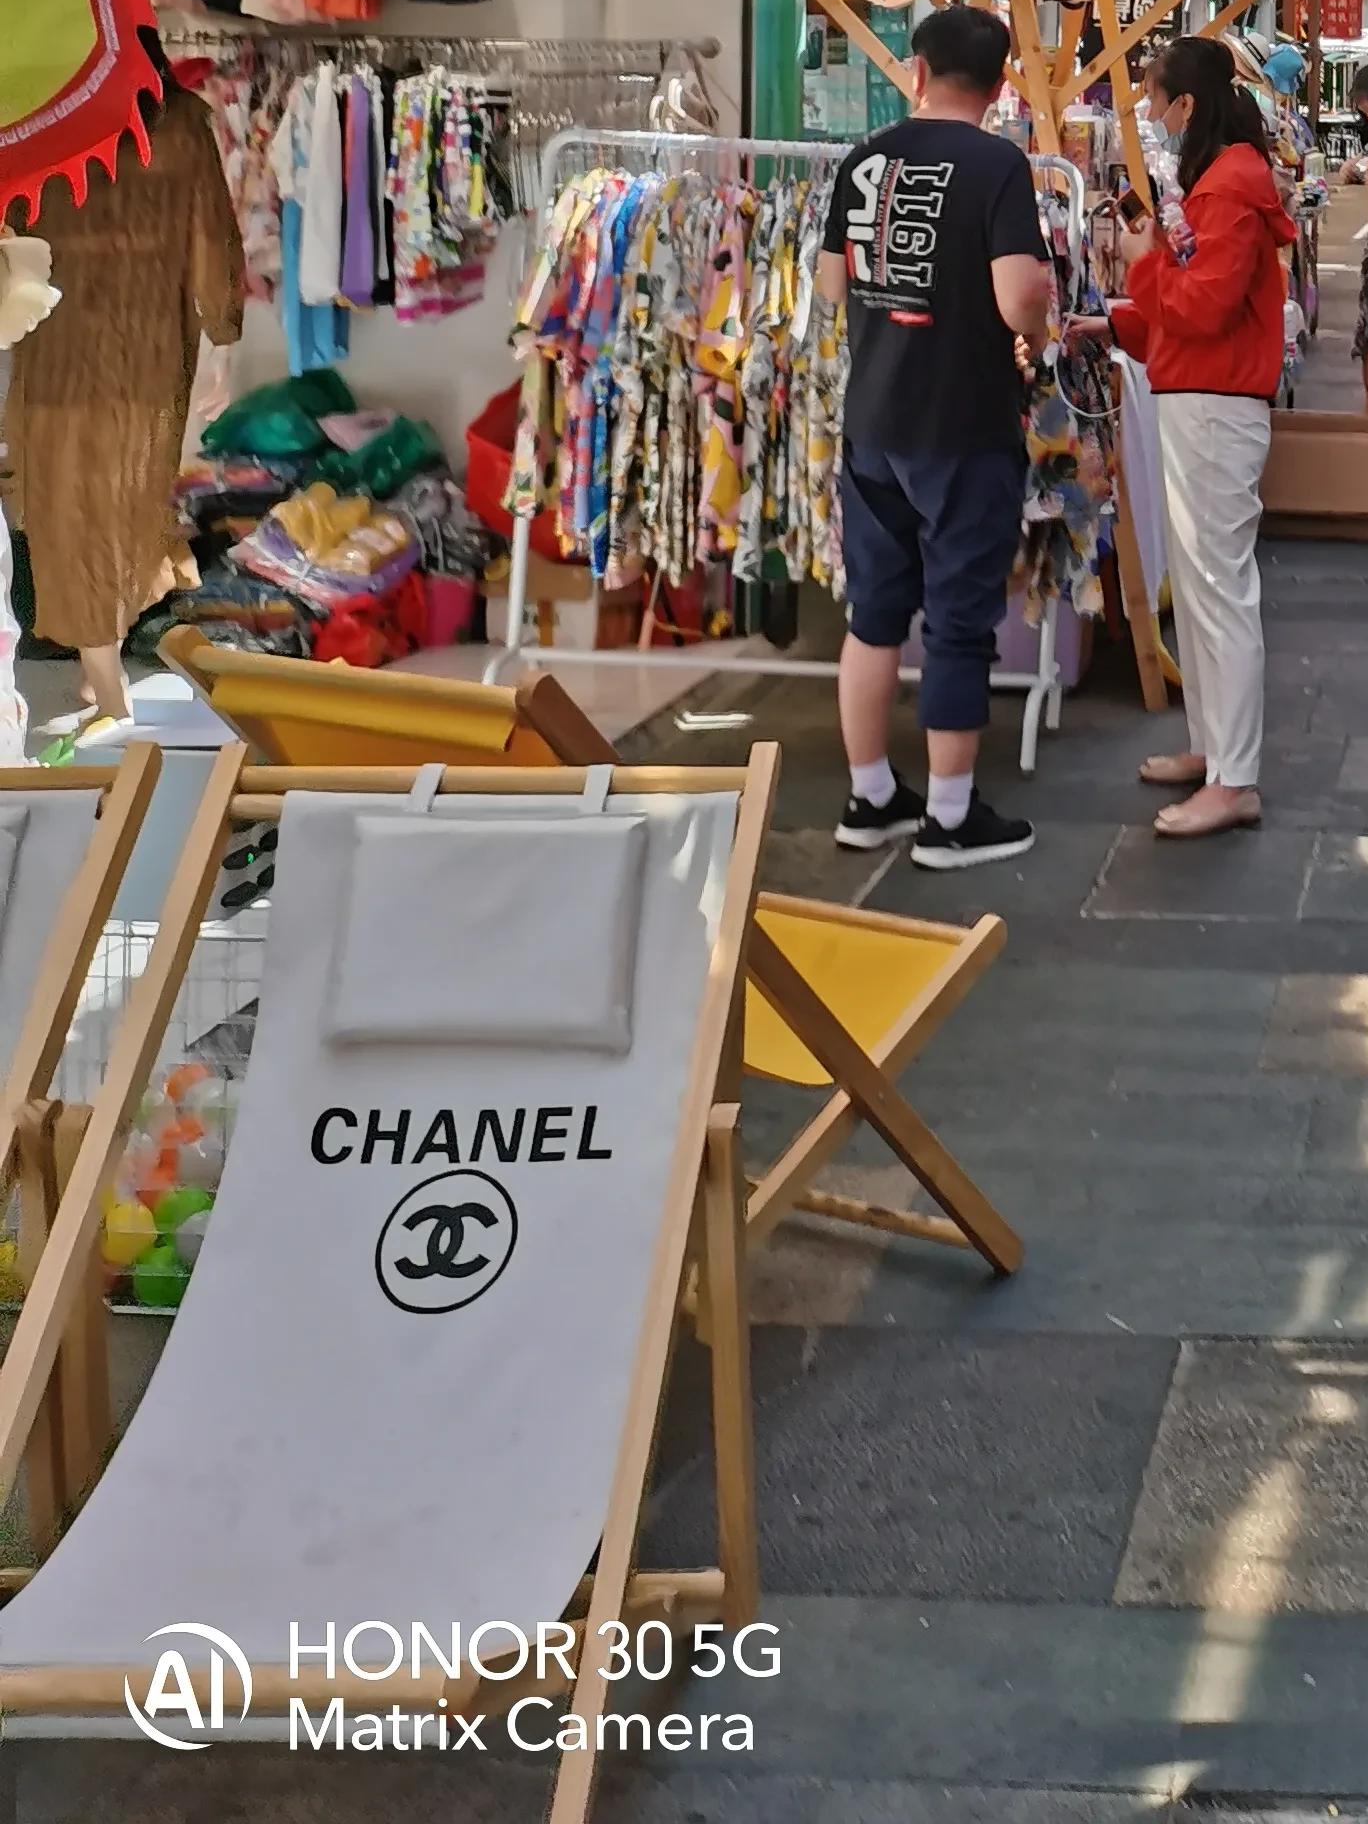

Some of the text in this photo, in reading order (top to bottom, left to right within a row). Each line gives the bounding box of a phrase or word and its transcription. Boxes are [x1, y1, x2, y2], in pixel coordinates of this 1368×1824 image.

[846, 153, 887, 283] FILA
[888, 162, 954, 288] 1911
[311, 1106, 613, 1164] CHANEL
